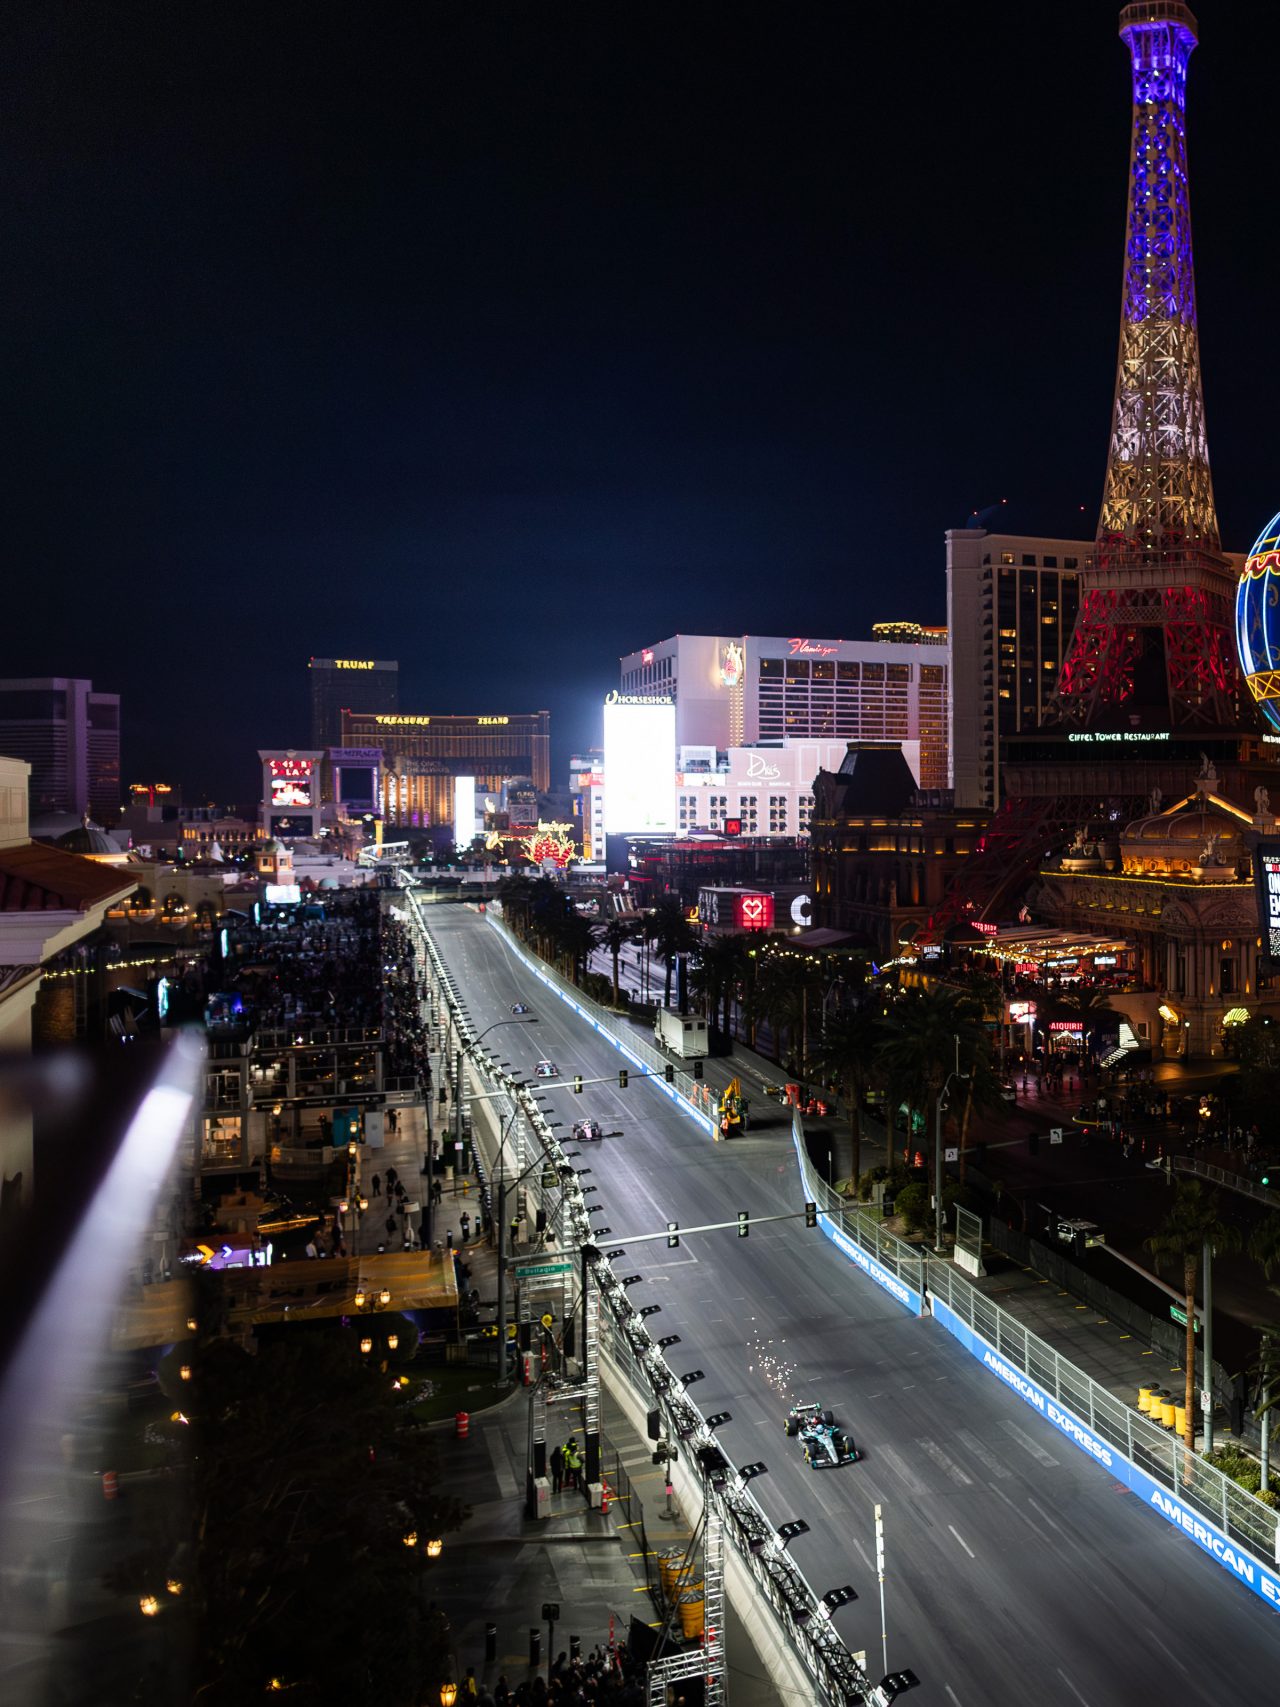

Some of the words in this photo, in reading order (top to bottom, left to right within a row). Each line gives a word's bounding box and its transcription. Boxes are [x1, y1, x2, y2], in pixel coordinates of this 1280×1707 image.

[788, 638, 839, 657] Flamingo
[335, 659, 375, 669] TRUMP
[375, 716, 430, 725] TREASURE
[478, 716, 509, 725] ISLAND
[1069, 733, 1093, 742] EIFFEL
[1095, 732, 1121, 742] TOWER
[1123, 731, 1171, 742] RESTAURANT
[1268, 873, 1280, 894] ON
[833, 1231, 869, 1270] AMERICAN
[870, 1263, 909, 1303] EXPRESS
[984, 1351, 1044, 1410] AMERICAN
[1048, 1402, 1113, 1467] EXPRESS
[1151, 1490, 1254, 1584] AMERICAN
